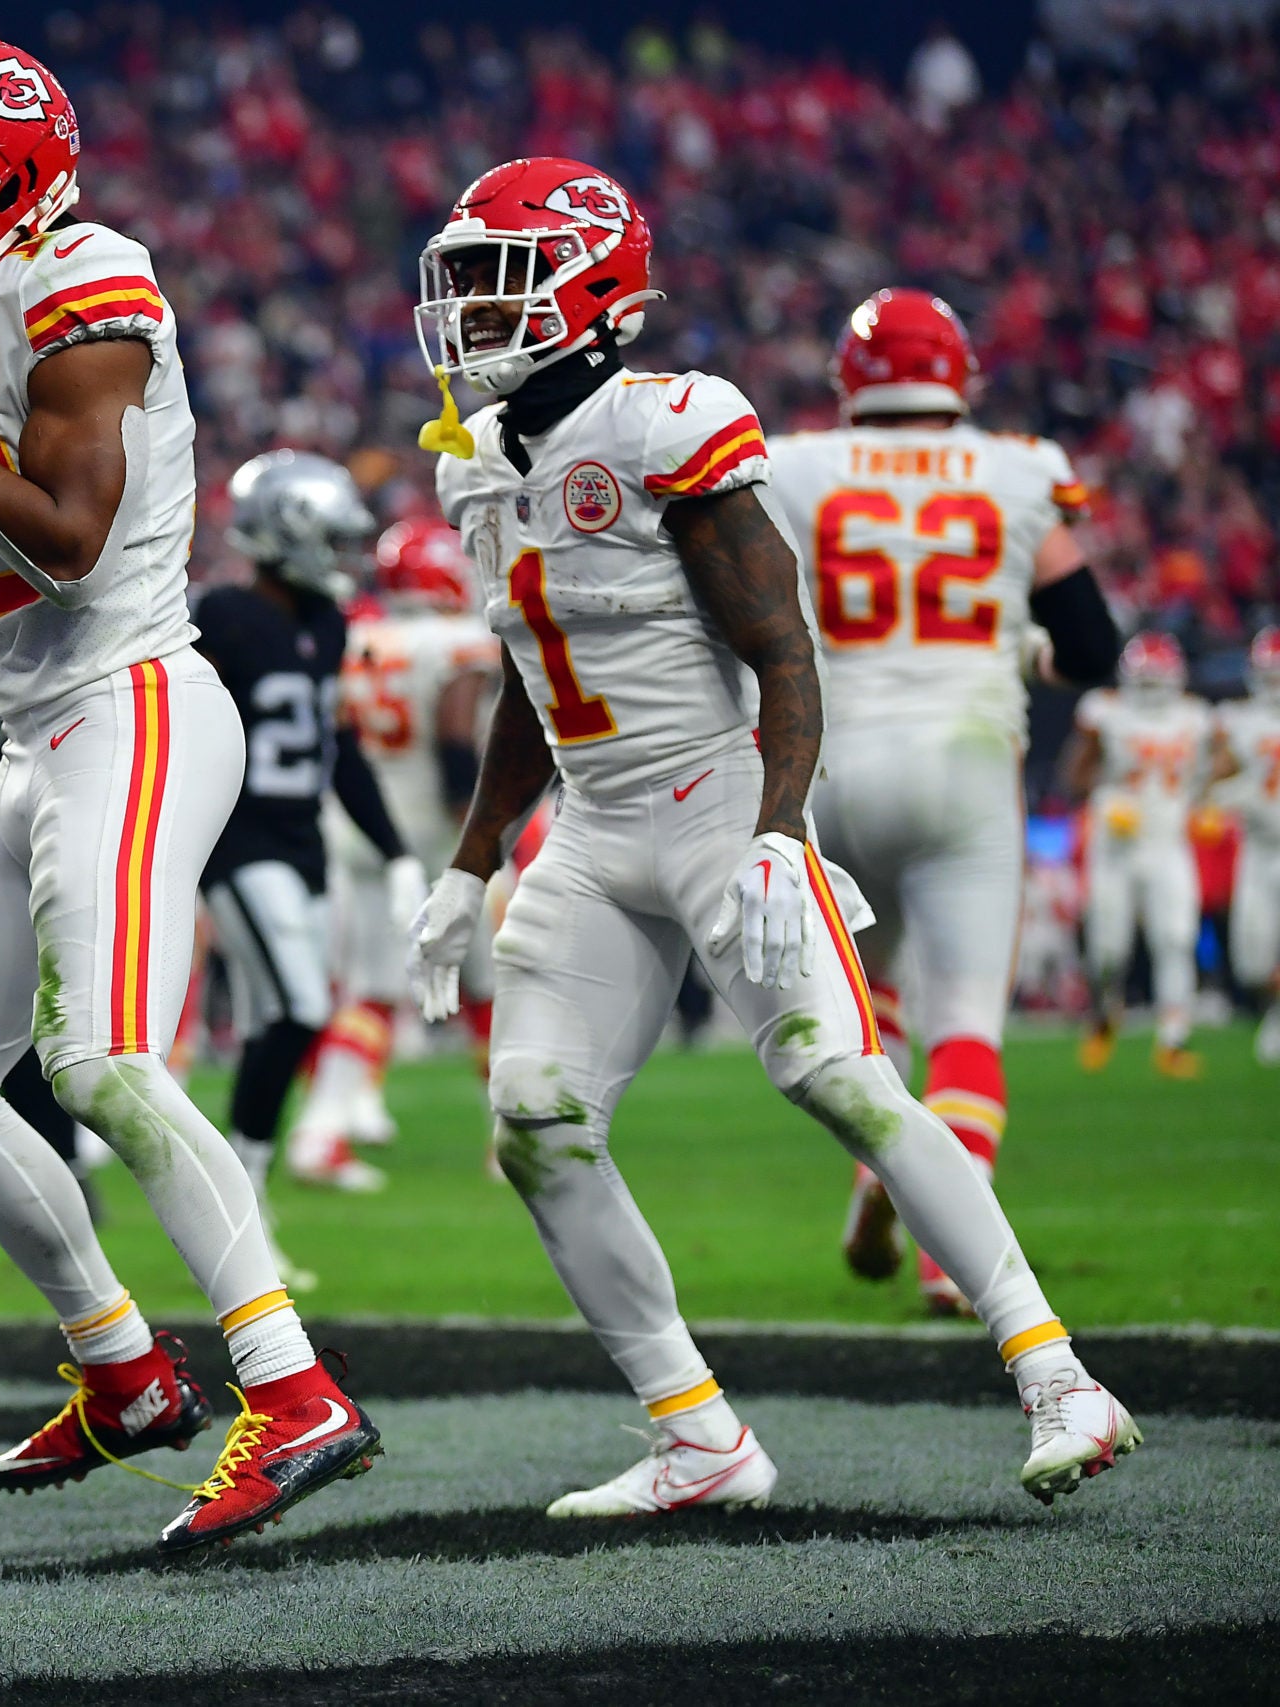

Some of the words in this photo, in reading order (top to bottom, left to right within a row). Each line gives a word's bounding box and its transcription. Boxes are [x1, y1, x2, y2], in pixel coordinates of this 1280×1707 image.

[563, 186, 622, 220] KC
[815, 487, 1004, 648] 62
[508, 547, 619, 745] 1
[120, 1377, 170, 1437] NIKE
